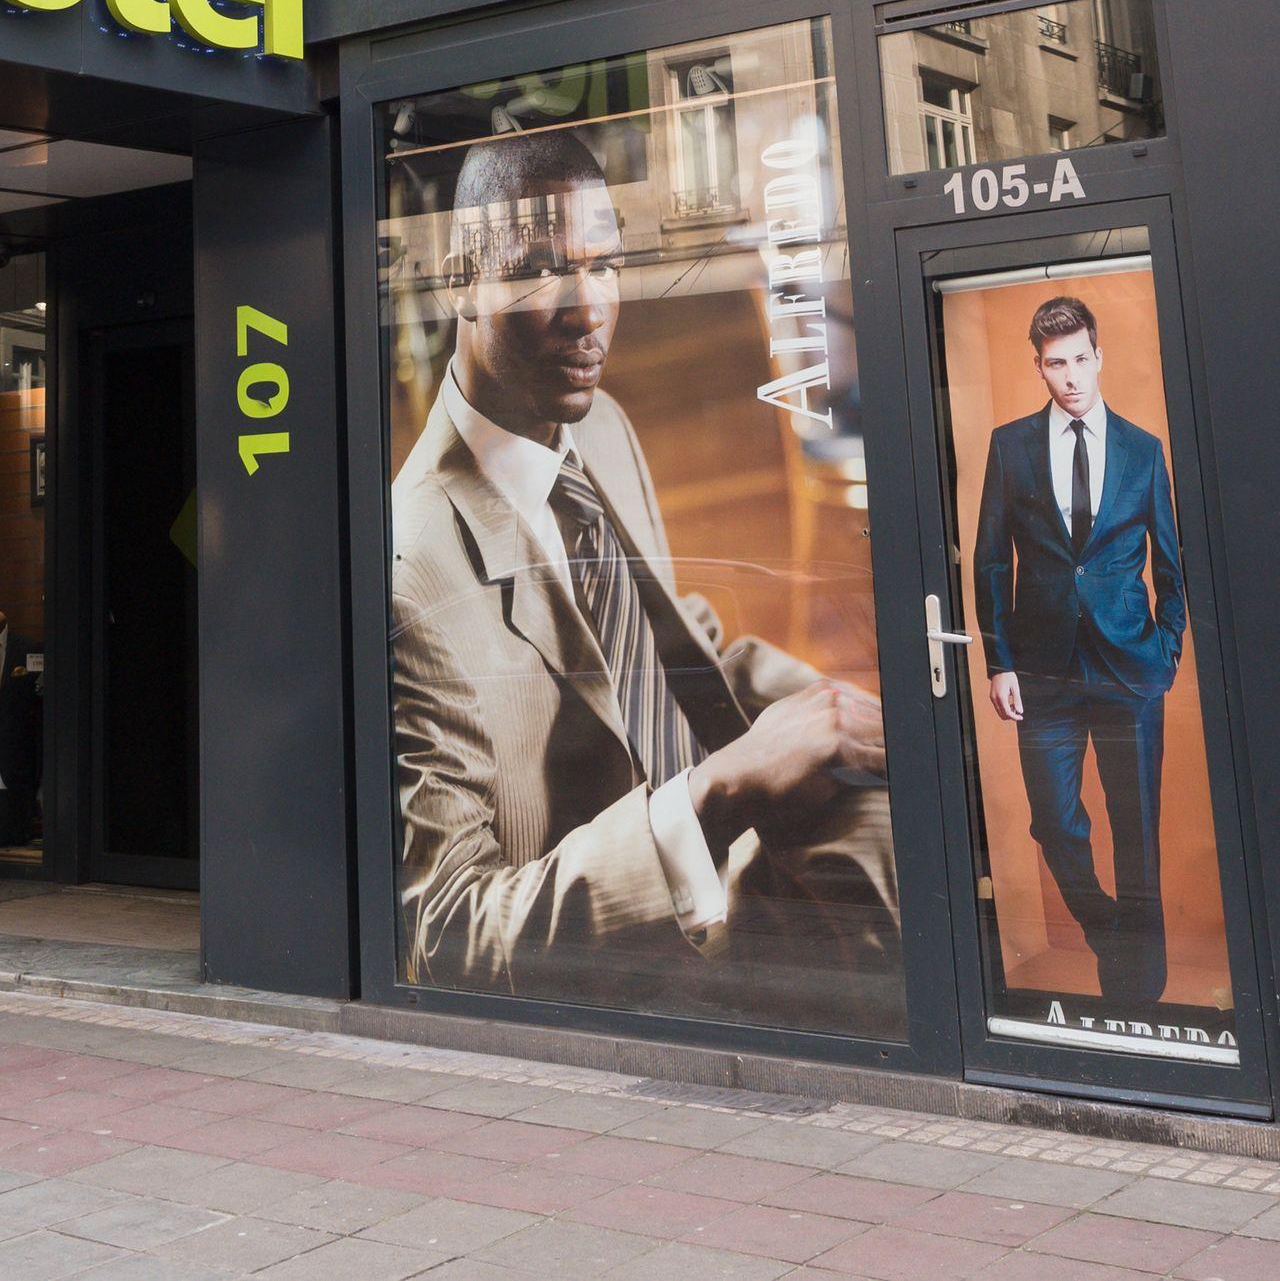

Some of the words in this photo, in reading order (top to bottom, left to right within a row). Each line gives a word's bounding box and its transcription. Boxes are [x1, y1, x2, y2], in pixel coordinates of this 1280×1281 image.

[943, 158, 1087, 215] 105-A
[756, 138, 834, 430] ALFREDO
[236, 305, 290, 476] 107
